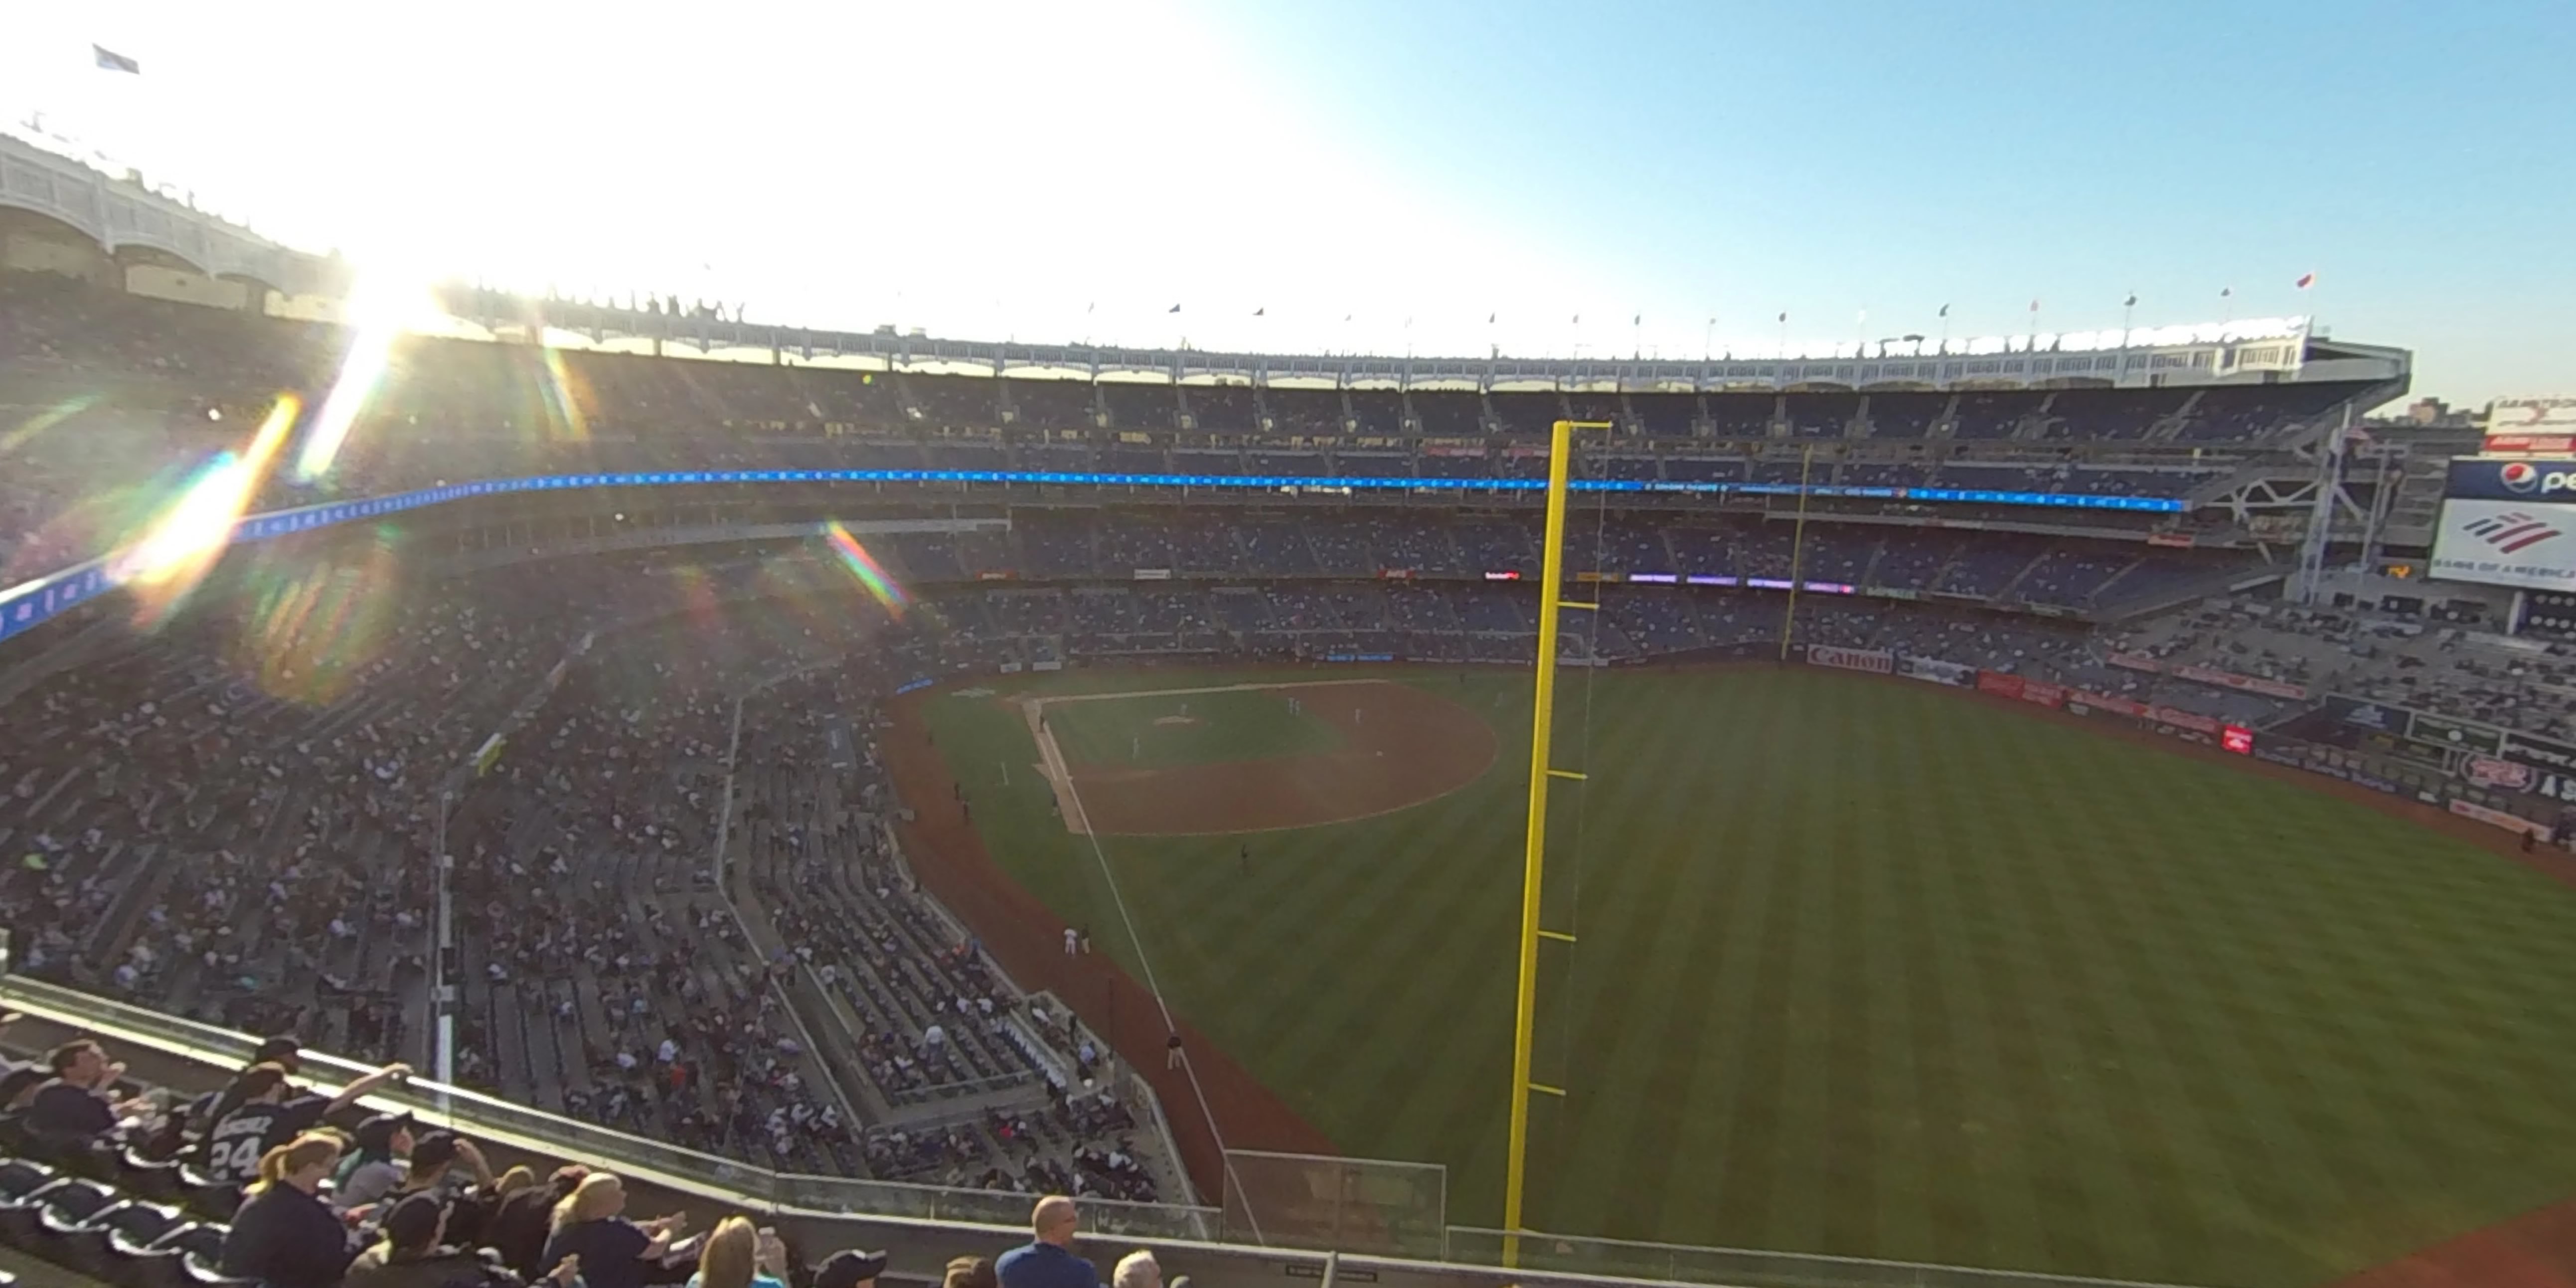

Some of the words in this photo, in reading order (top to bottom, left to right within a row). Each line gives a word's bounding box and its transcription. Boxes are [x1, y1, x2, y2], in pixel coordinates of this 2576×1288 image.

[2432, 559, 2474, 570] BANK
[2478, 562, 2499, 571] OF
[1810, 647, 1891, 670] Canon
[210, 1135, 262, 1180] 24
